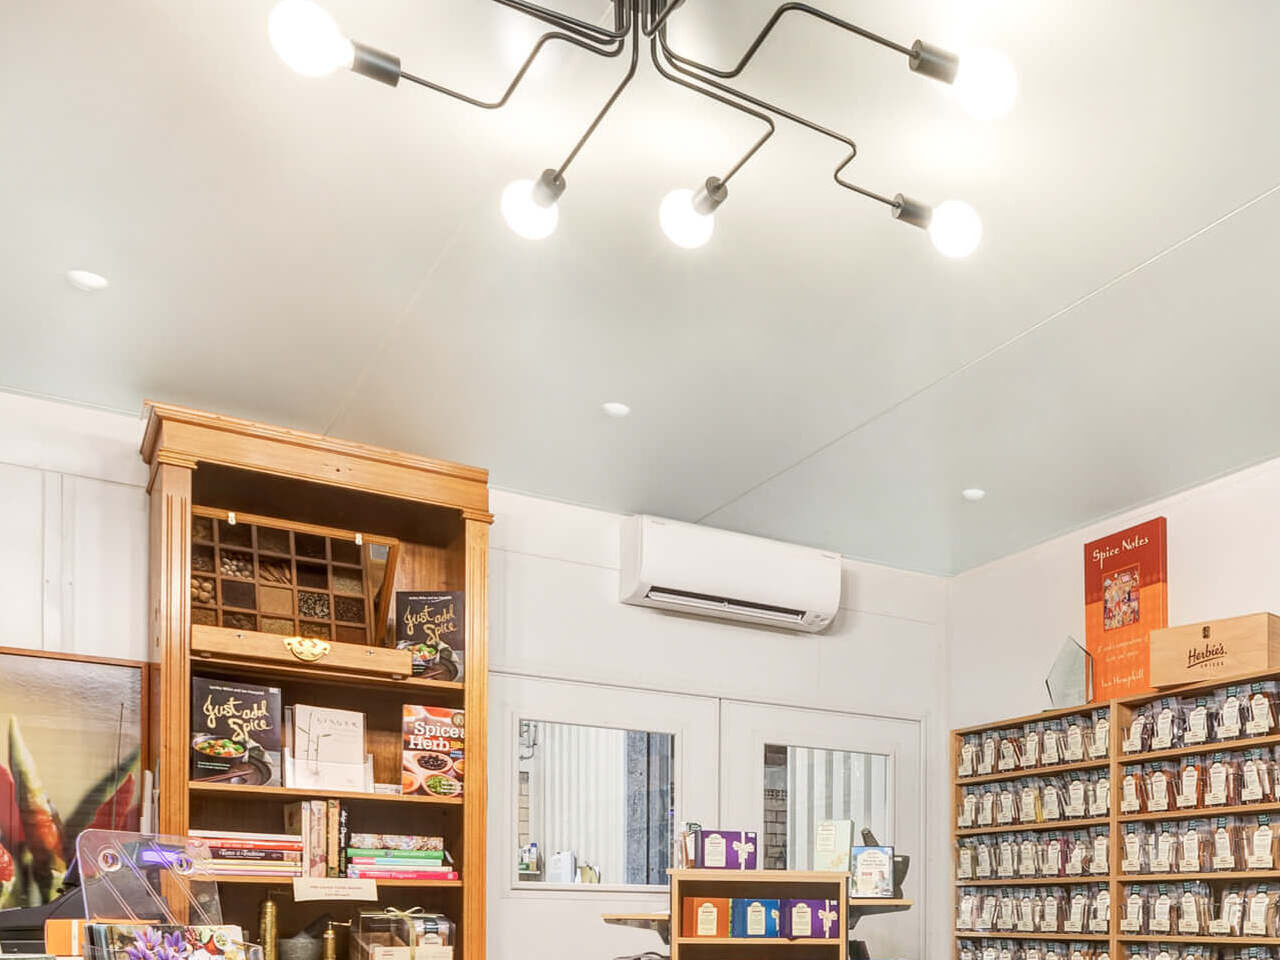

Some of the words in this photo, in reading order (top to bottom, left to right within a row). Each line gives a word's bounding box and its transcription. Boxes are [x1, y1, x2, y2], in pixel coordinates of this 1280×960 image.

[1092, 545, 1120, 569] Spice
[1121, 535, 1149, 551] Notes
[423, 623, 457, 645] Spice
[203, 694, 242, 728] Just
[243, 700, 269, 719] add
[227, 718, 273, 741] Spice
[414, 721, 459, 739] Spice
[408, 735, 450, 751] Herb
